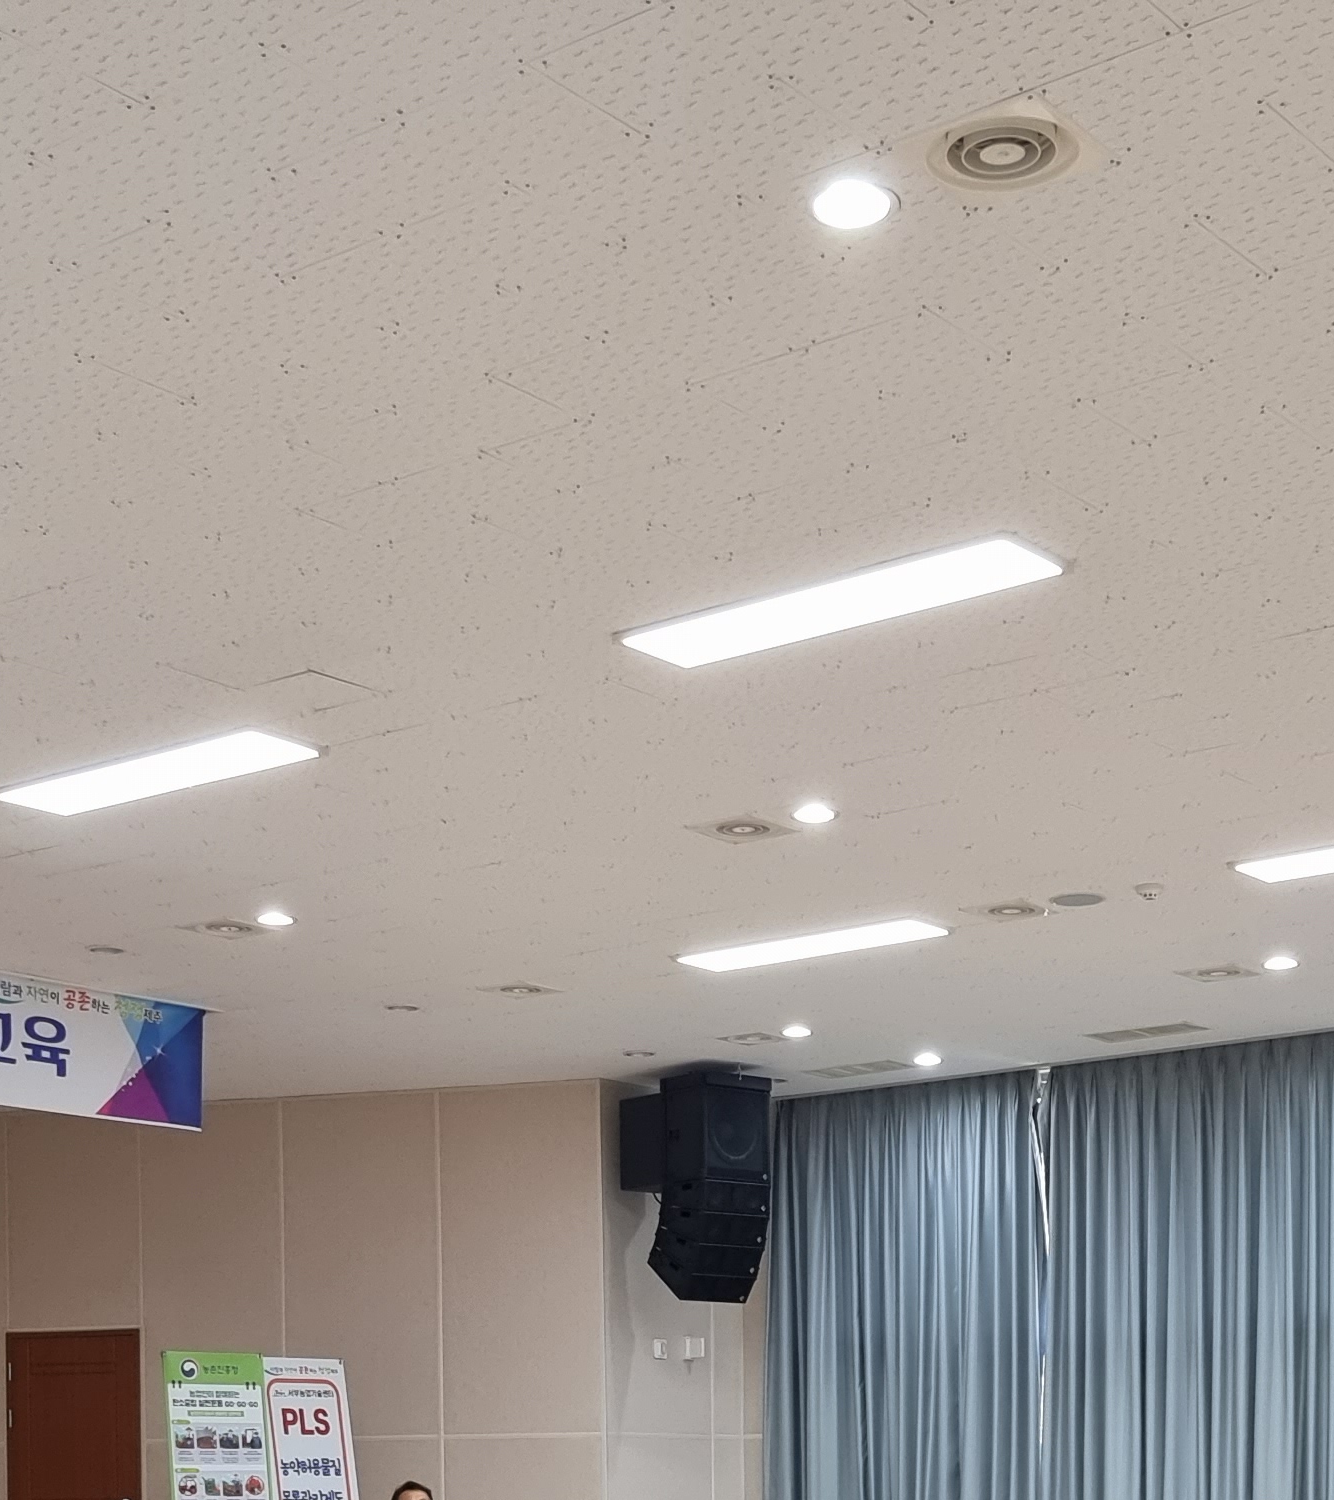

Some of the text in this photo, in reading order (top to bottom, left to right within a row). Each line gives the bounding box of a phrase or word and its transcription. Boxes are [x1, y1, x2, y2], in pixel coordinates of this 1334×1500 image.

[25, 985, 60, 1005] 자연이
[63, 989, 111, 1015] 공존하는
[281, 1407, 331, 1436] PLS
[280, 1457, 342, 1477] 농약허용물질
